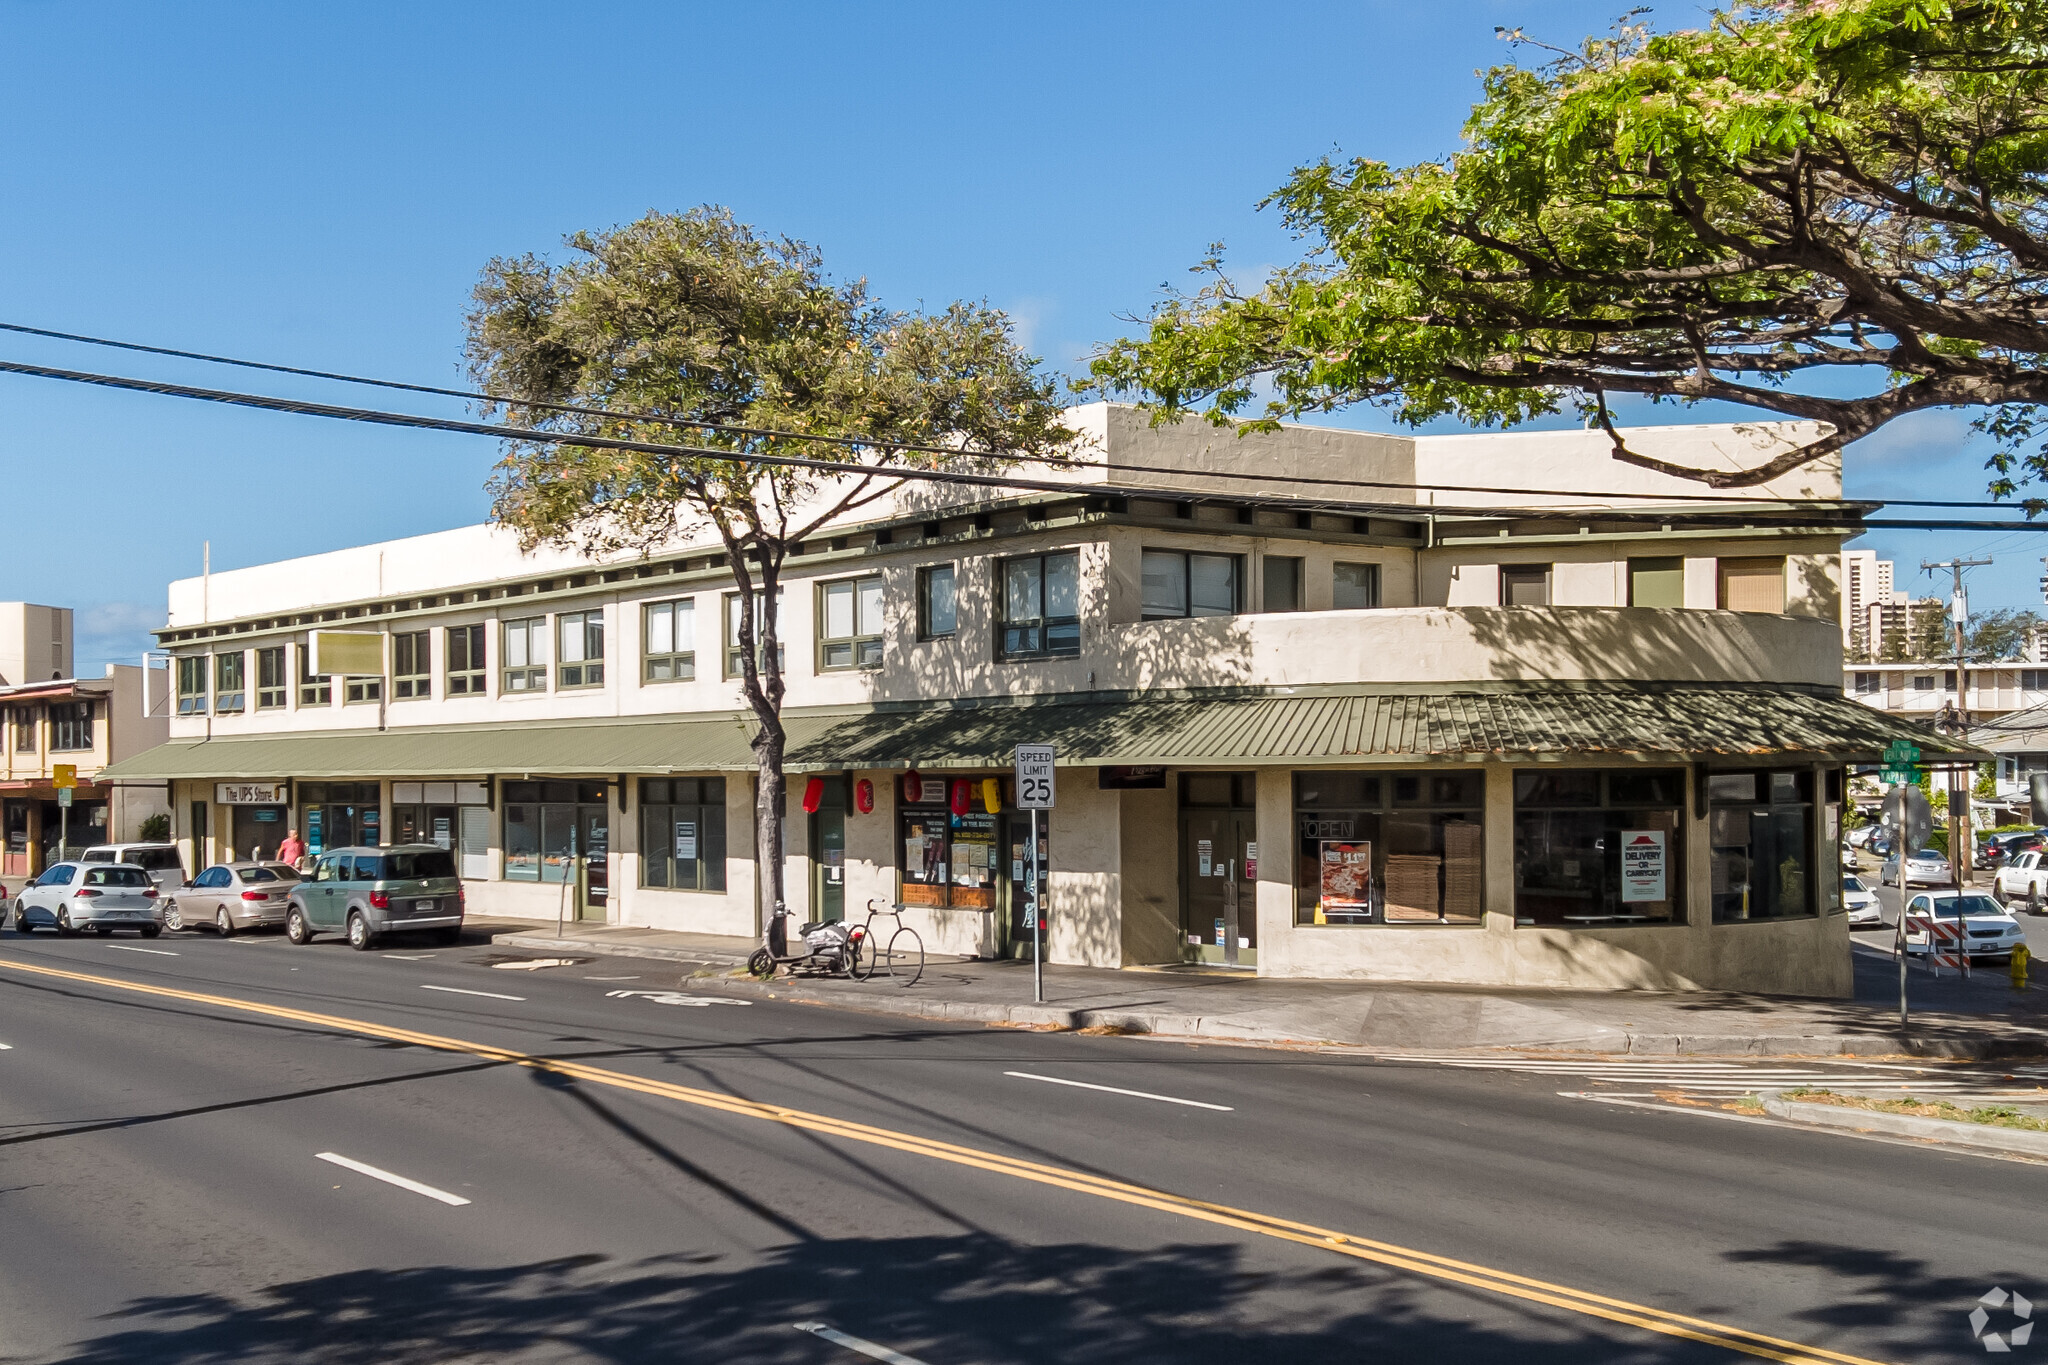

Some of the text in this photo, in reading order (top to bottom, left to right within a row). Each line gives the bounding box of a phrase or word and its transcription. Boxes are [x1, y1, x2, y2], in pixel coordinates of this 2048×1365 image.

[1020, 753, 1051, 763] SPEED
[1023, 766, 1048, 775] LIMIT
[226, 786, 272, 802] The UPS Store
[1022, 778, 1051, 802] 25
[1306, 822, 1352, 837] OPEN
[1625, 852, 1661, 860] DELIVERY
[1626, 869, 1661, 877] CARRYOUT
